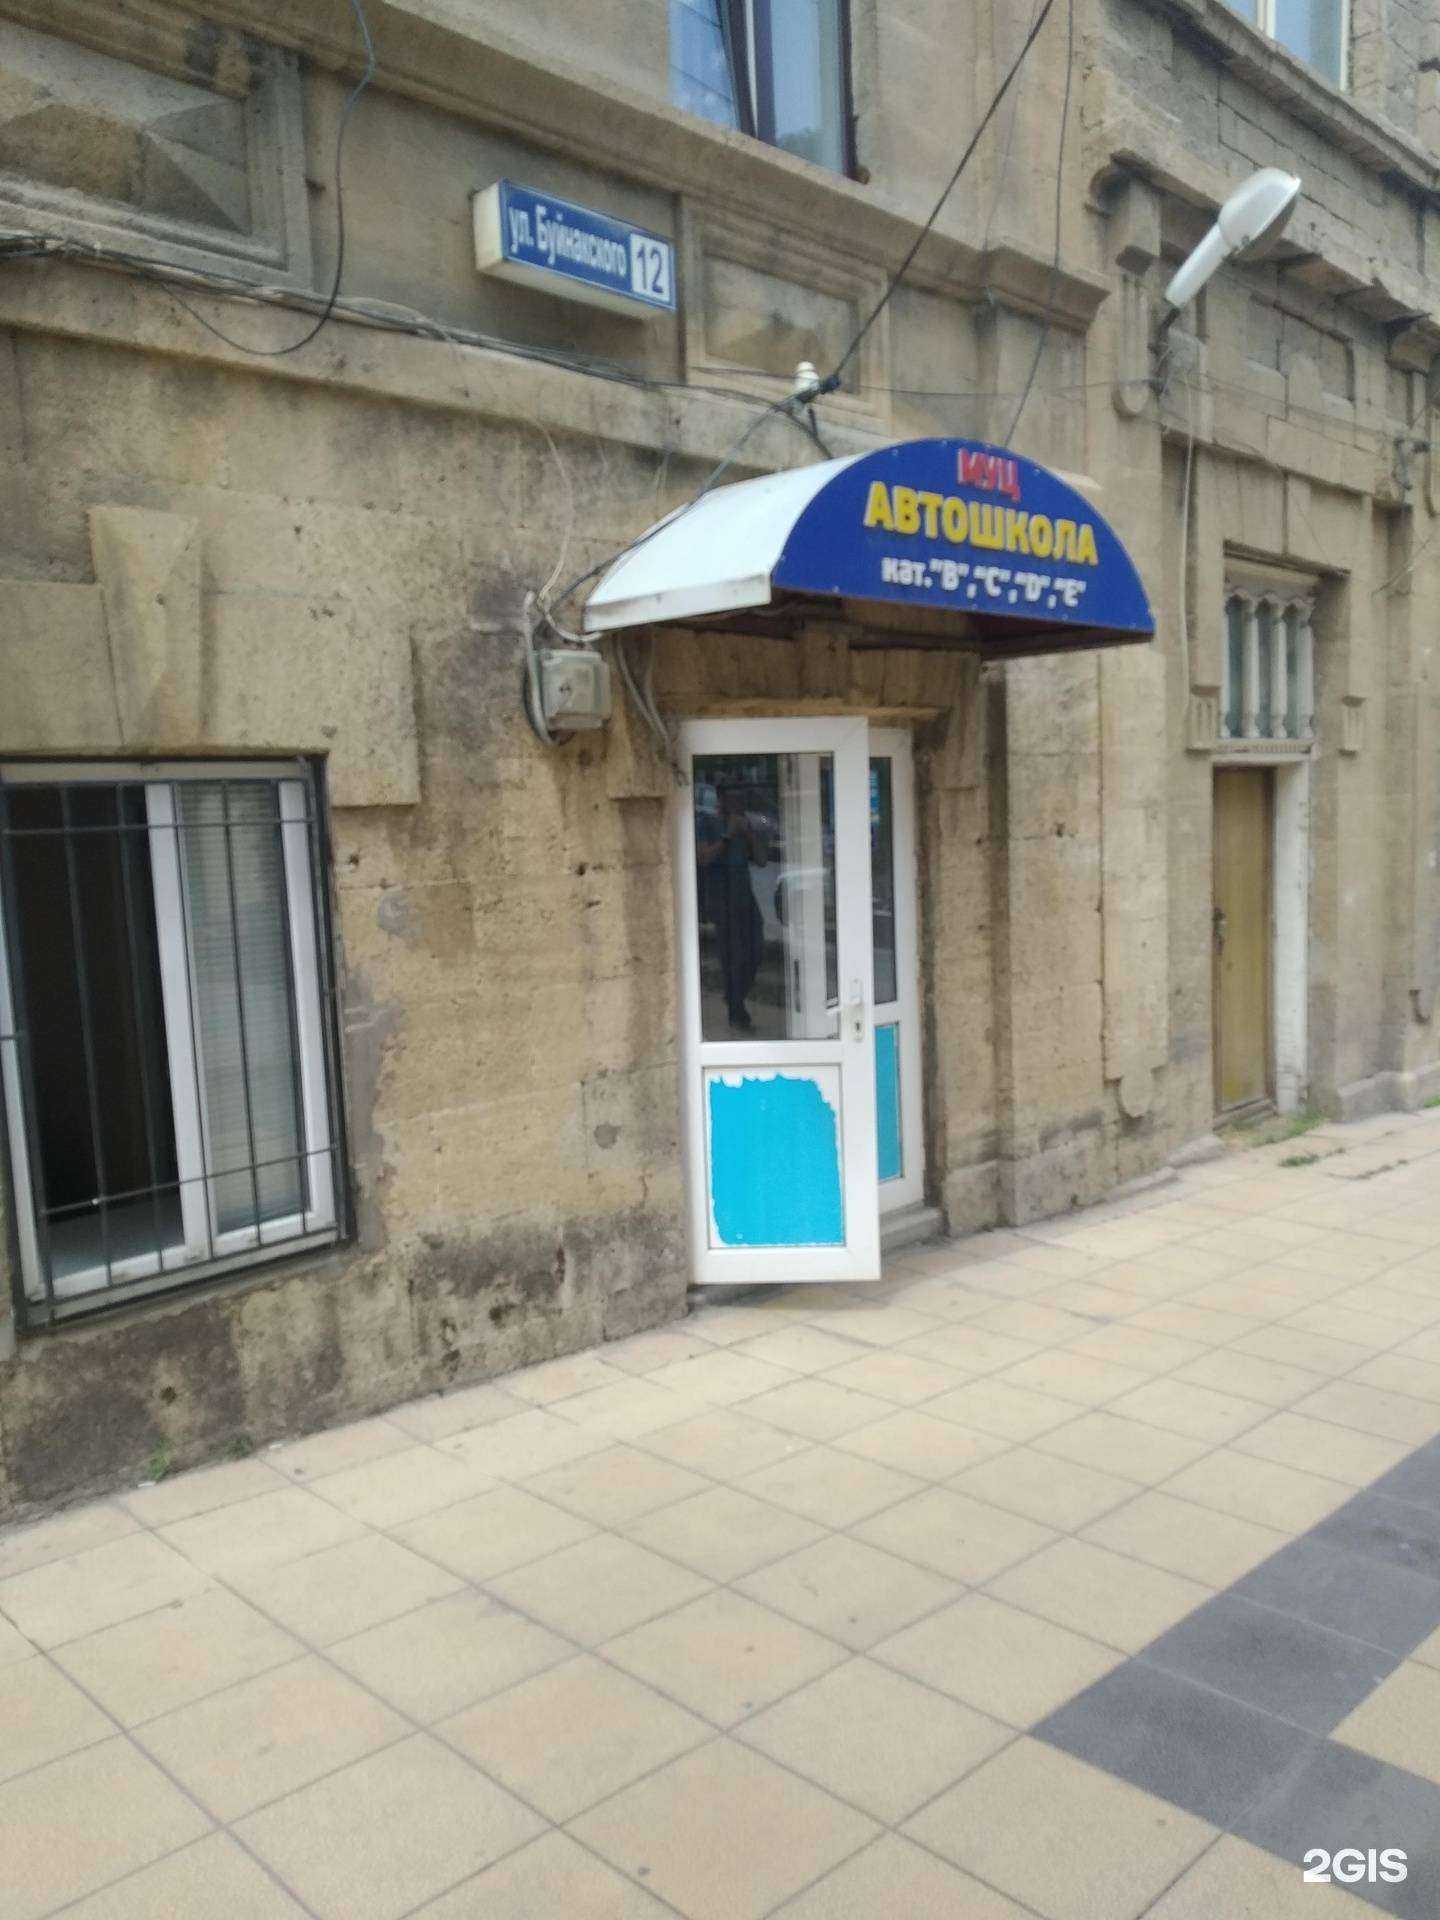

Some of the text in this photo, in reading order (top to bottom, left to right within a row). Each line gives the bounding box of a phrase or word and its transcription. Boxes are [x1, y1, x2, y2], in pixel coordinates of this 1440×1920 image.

[508, 206, 535, 254] ул.
[636, 241, 665, 294] 12
[863, 480, 1098, 566] АВТОШКОЛА
